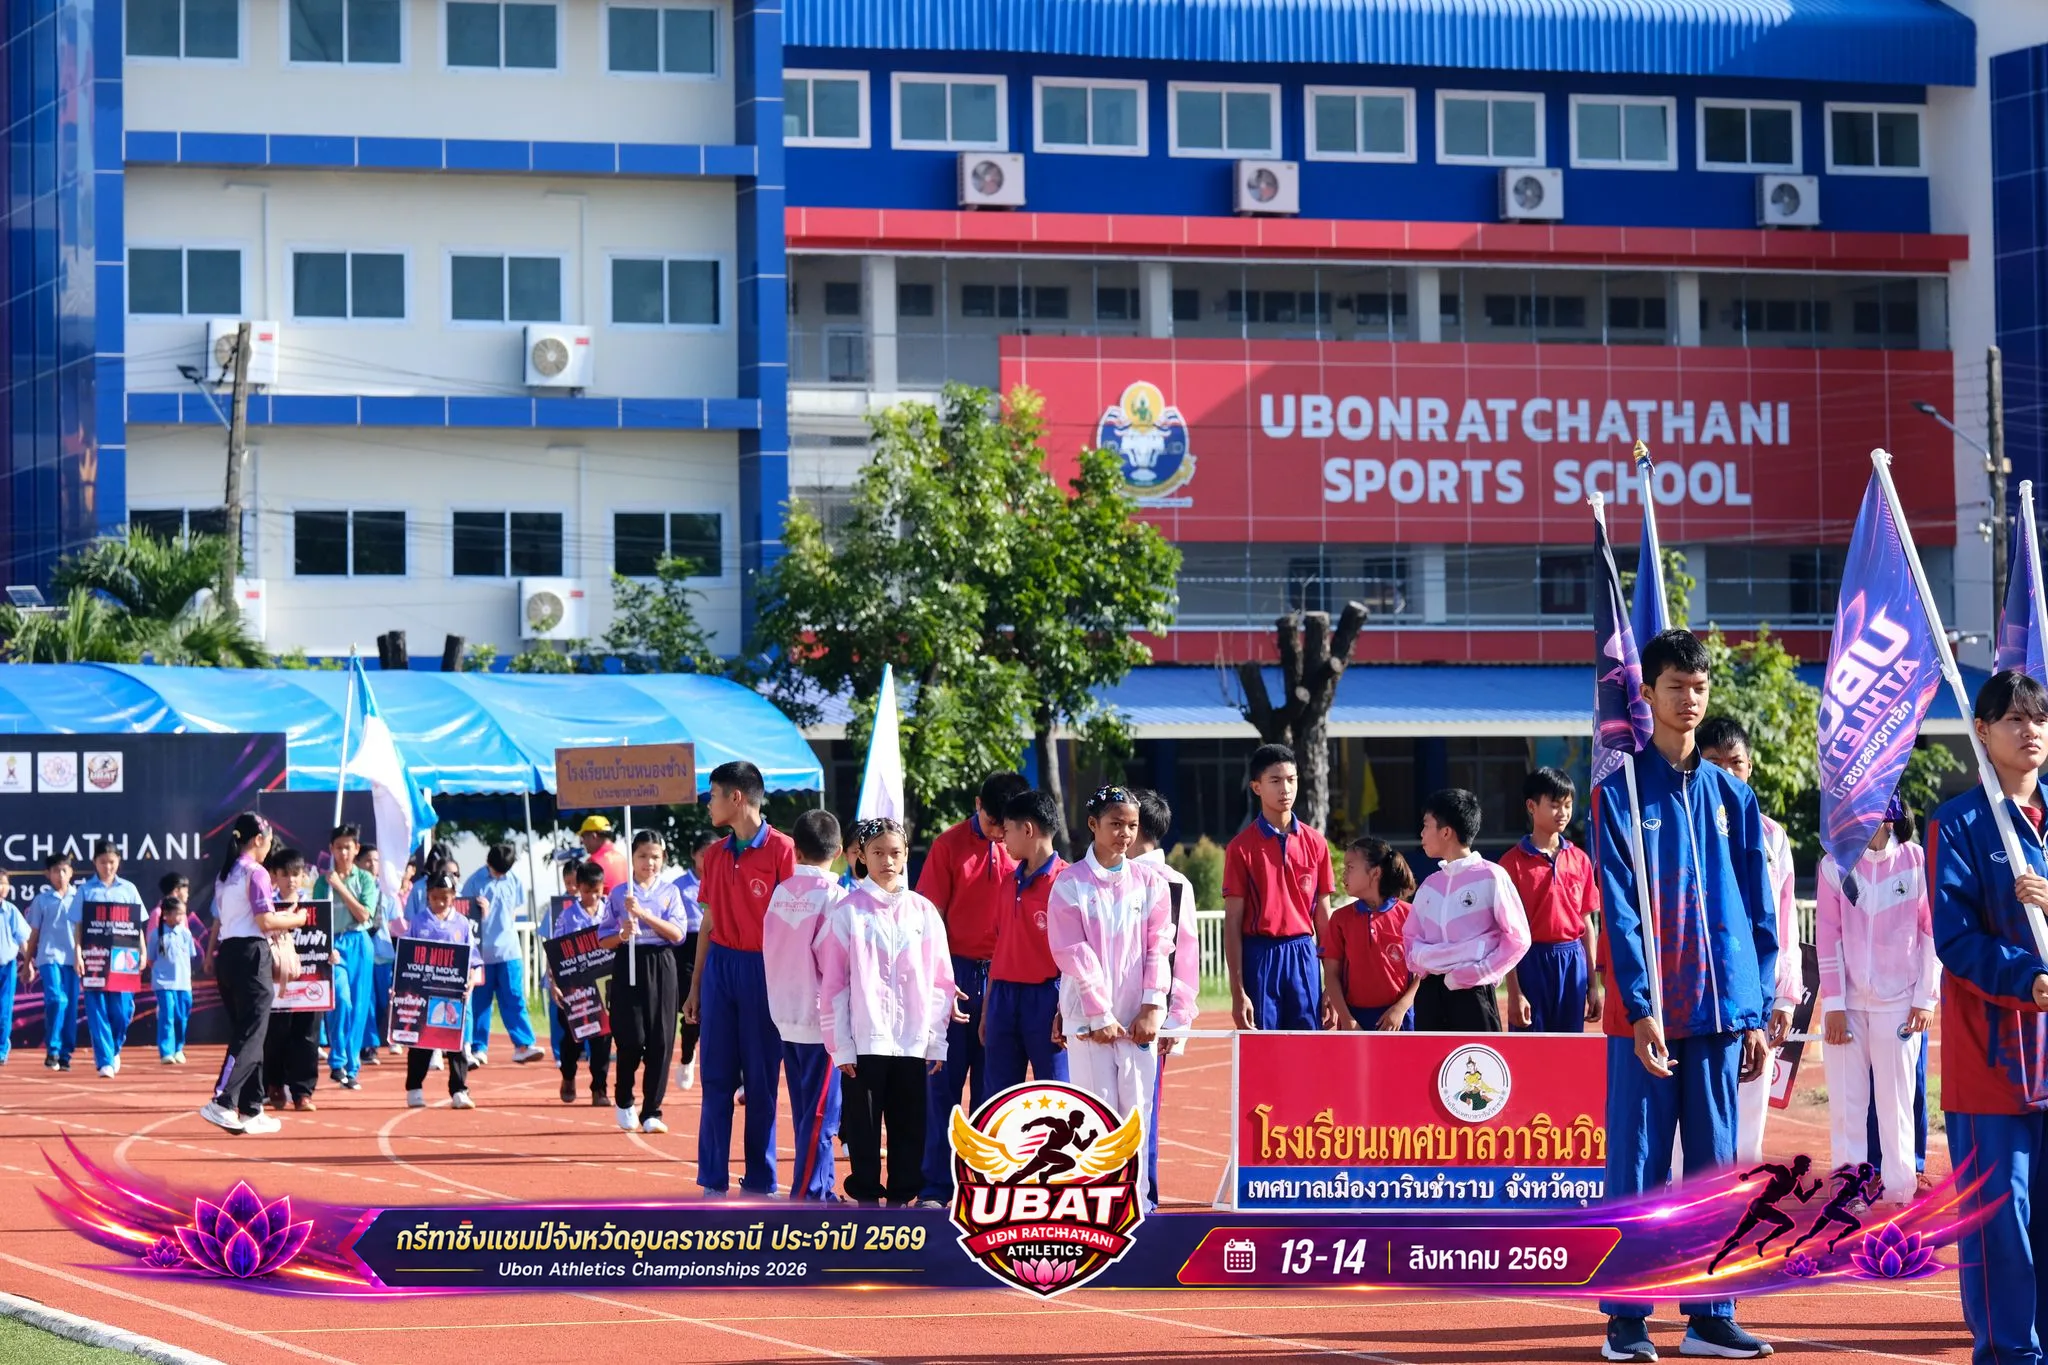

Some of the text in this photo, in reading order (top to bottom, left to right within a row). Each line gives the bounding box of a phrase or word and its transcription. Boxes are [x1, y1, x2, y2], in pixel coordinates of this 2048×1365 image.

[1260, 394, 1790, 445] UBONRATCHATHANI
[1323, 457, 1752, 506] SPORTS SCHOOL
[0, 833, 200, 861] CHATHANI
[407, 963, 424, 972] YOU
[436, 966, 459, 975] MOVE
[1248, 1172, 1604, 1208] เทศบาลเมืองวารินชำราบ จังหวัดอุบ
